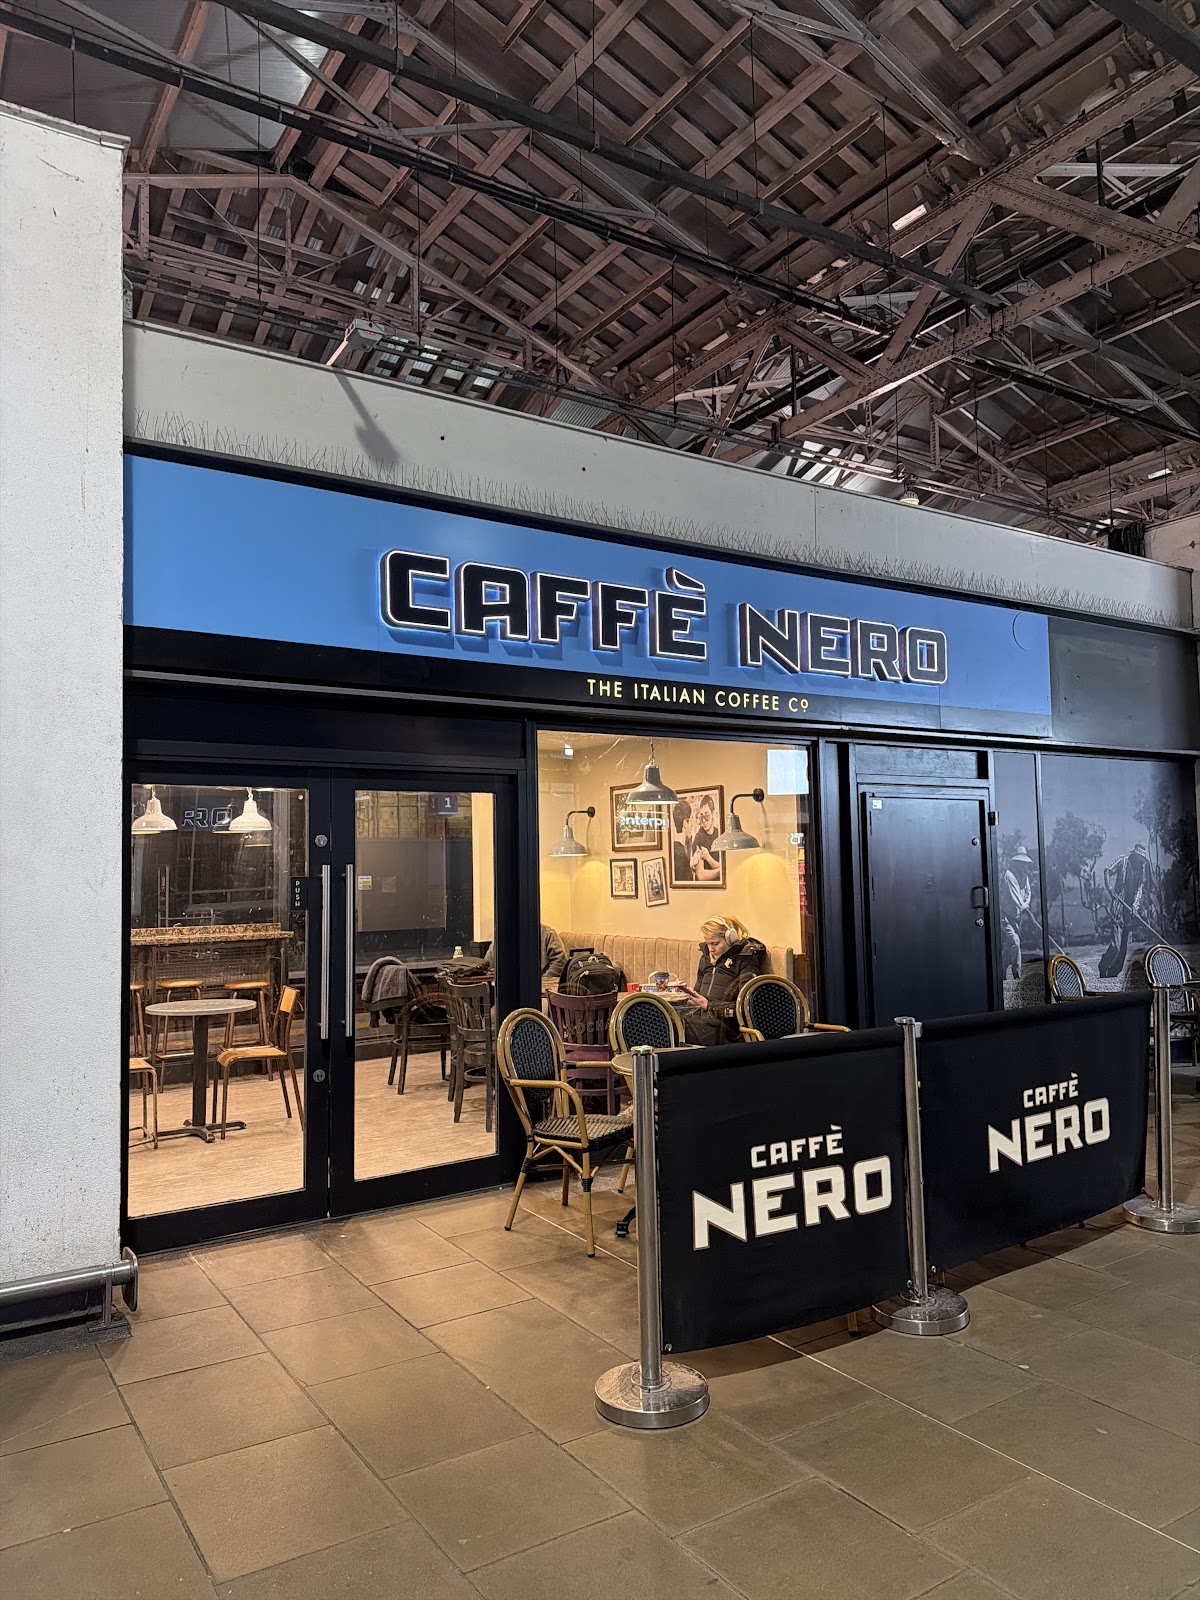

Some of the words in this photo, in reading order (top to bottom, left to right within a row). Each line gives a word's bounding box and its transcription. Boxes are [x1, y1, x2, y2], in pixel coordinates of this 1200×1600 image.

[381, 549, 707, 661] CAFFÈ
[739, 602, 949, 685] NERO
[586, 678, 623, 698] THE
[634, 683, 705, 705] ITALIAN
[714, 690, 780, 712] COFFEE
[444, 796, 452, 808] 1
[1022, 1073, 1079, 1109] CAFFÈ
[750, 1125, 844, 1169] CAFFÈ
[987, 1097, 1111, 1173] NERO
[693, 1156, 892, 1249] NERO
